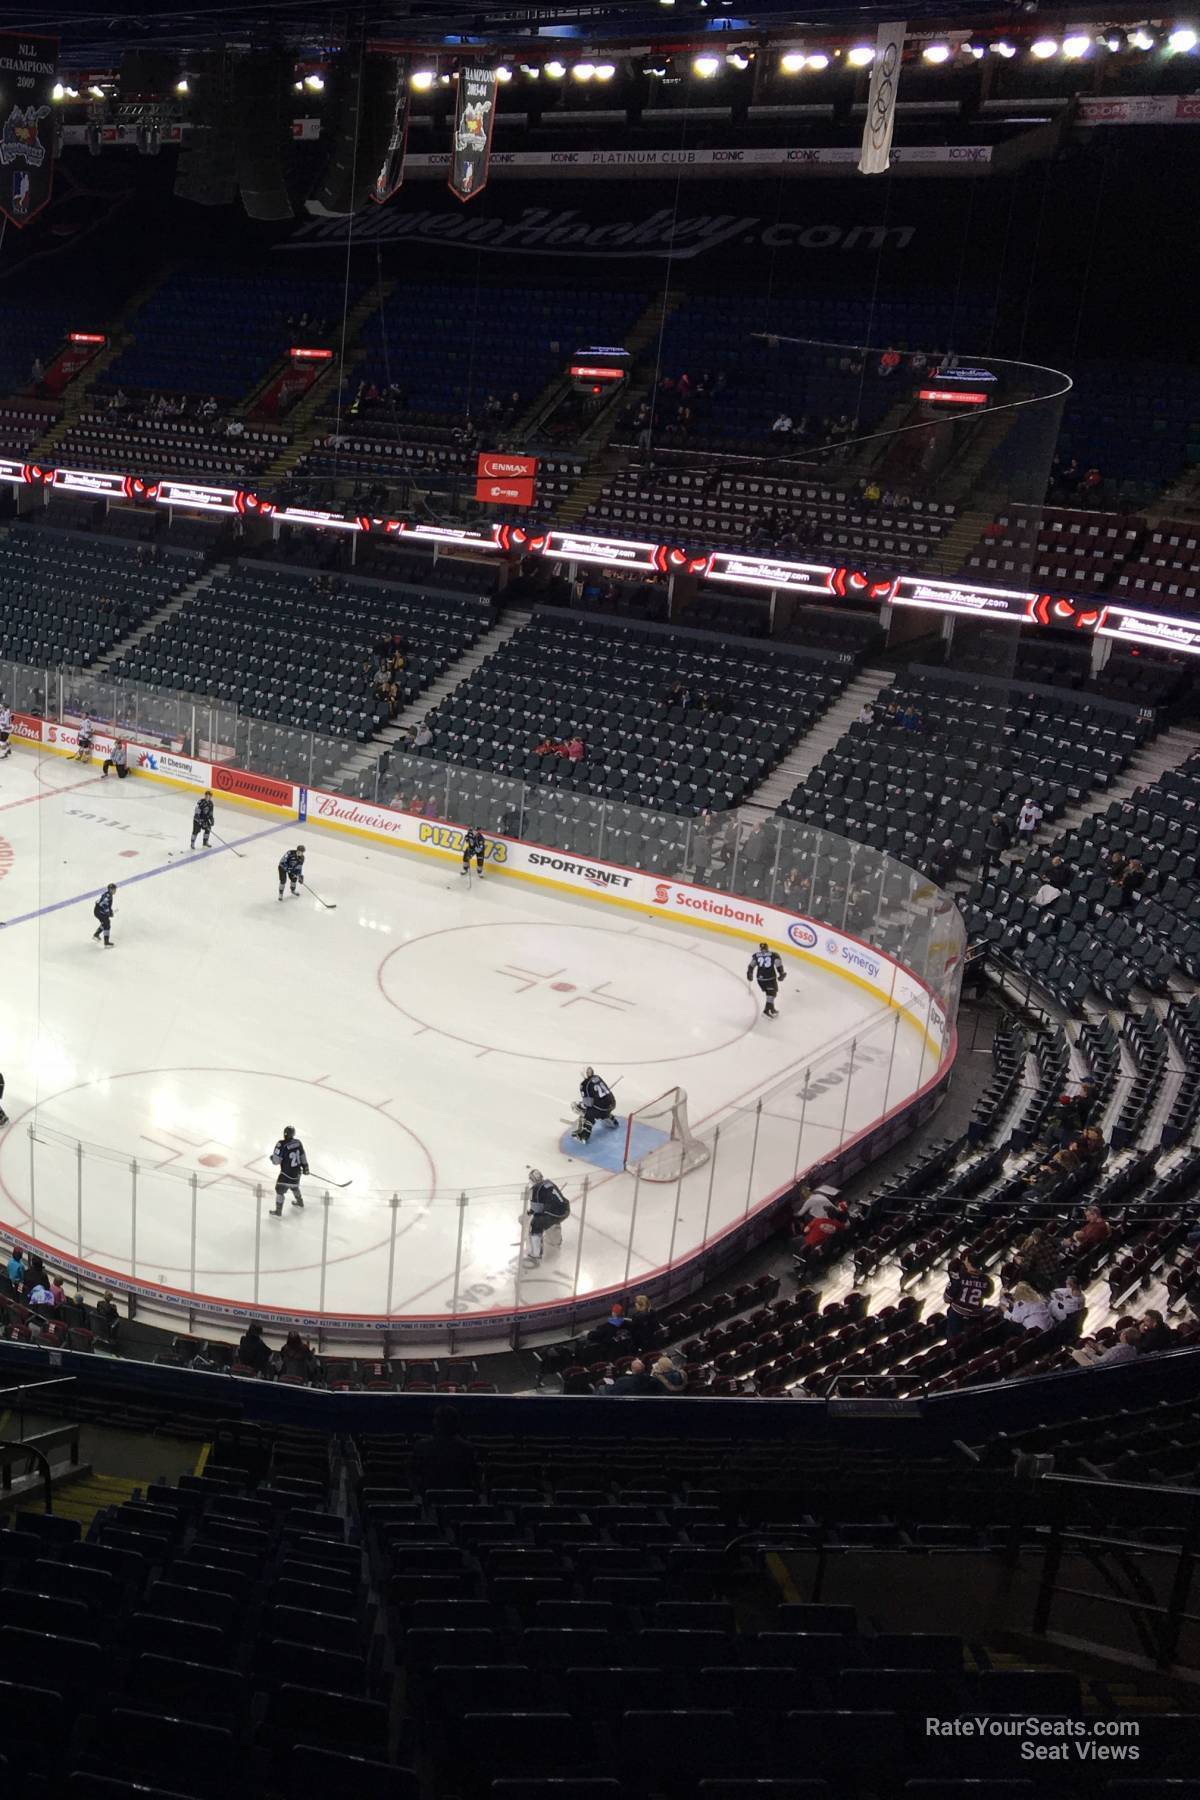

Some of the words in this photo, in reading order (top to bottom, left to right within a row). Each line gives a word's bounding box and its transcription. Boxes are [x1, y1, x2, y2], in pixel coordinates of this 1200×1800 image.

[18, 44, 37, 57] NLL
[0, 56, 54, 74] CHAMPIONS
[17, 75, 36, 89] 2009
[551, 152, 579, 162] ICONIC
[592, 152, 657, 164] PLATINUM
[661, 152, 696, 163] CLUB
[712, 151, 744, 161] ICONIC
[787, 150, 820, 160] ICONIC
[491, 462, 528, 474] ENMAX
[561, 539, 636, 560] HitmenHockey.com
[725, 559, 810, 583] HitmenHockey.com
[913, 585, 1009, 609] HitmenHockey.com
[1118, 616, 1200, 645] HitmenHockey.c
[60, 732, 113, 753] Scotbank
[168, 757, 193, 773] Chesney
[64, 808, 132, 831] TELUS
[316, 795, 402, 833] Budweiser
[528, 852, 633, 889] SPORTSNET
[676, 893, 764, 927] Scotiabank
[792, 926, 814, 943] Esso
[841, 946, 880, 977] Synergy
[960, 1287, 982, 1306] 12
